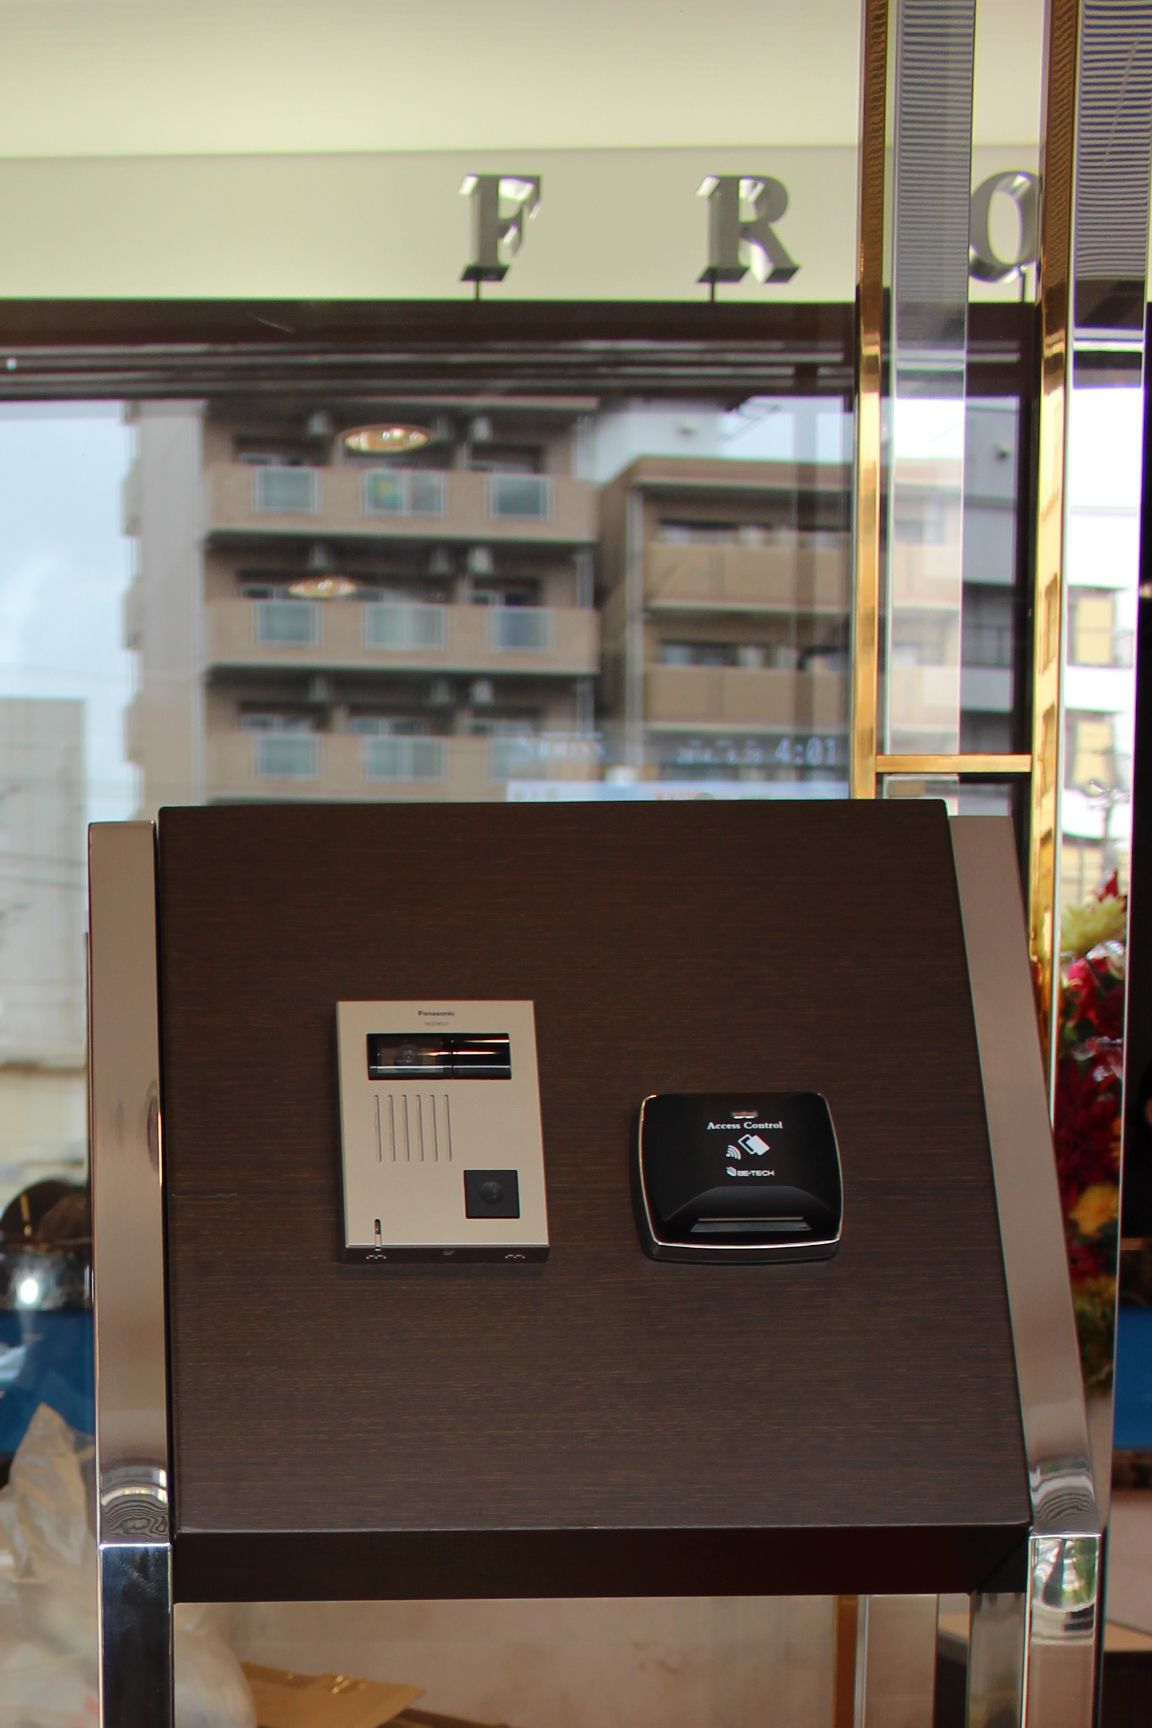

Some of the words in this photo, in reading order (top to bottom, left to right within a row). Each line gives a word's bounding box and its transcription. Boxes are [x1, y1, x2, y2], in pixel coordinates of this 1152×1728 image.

[417, 1009, 455, 1017] Panasonic
[706, 1121, 741, 1130] Access
[743, 1120, 784, 1130] Control
